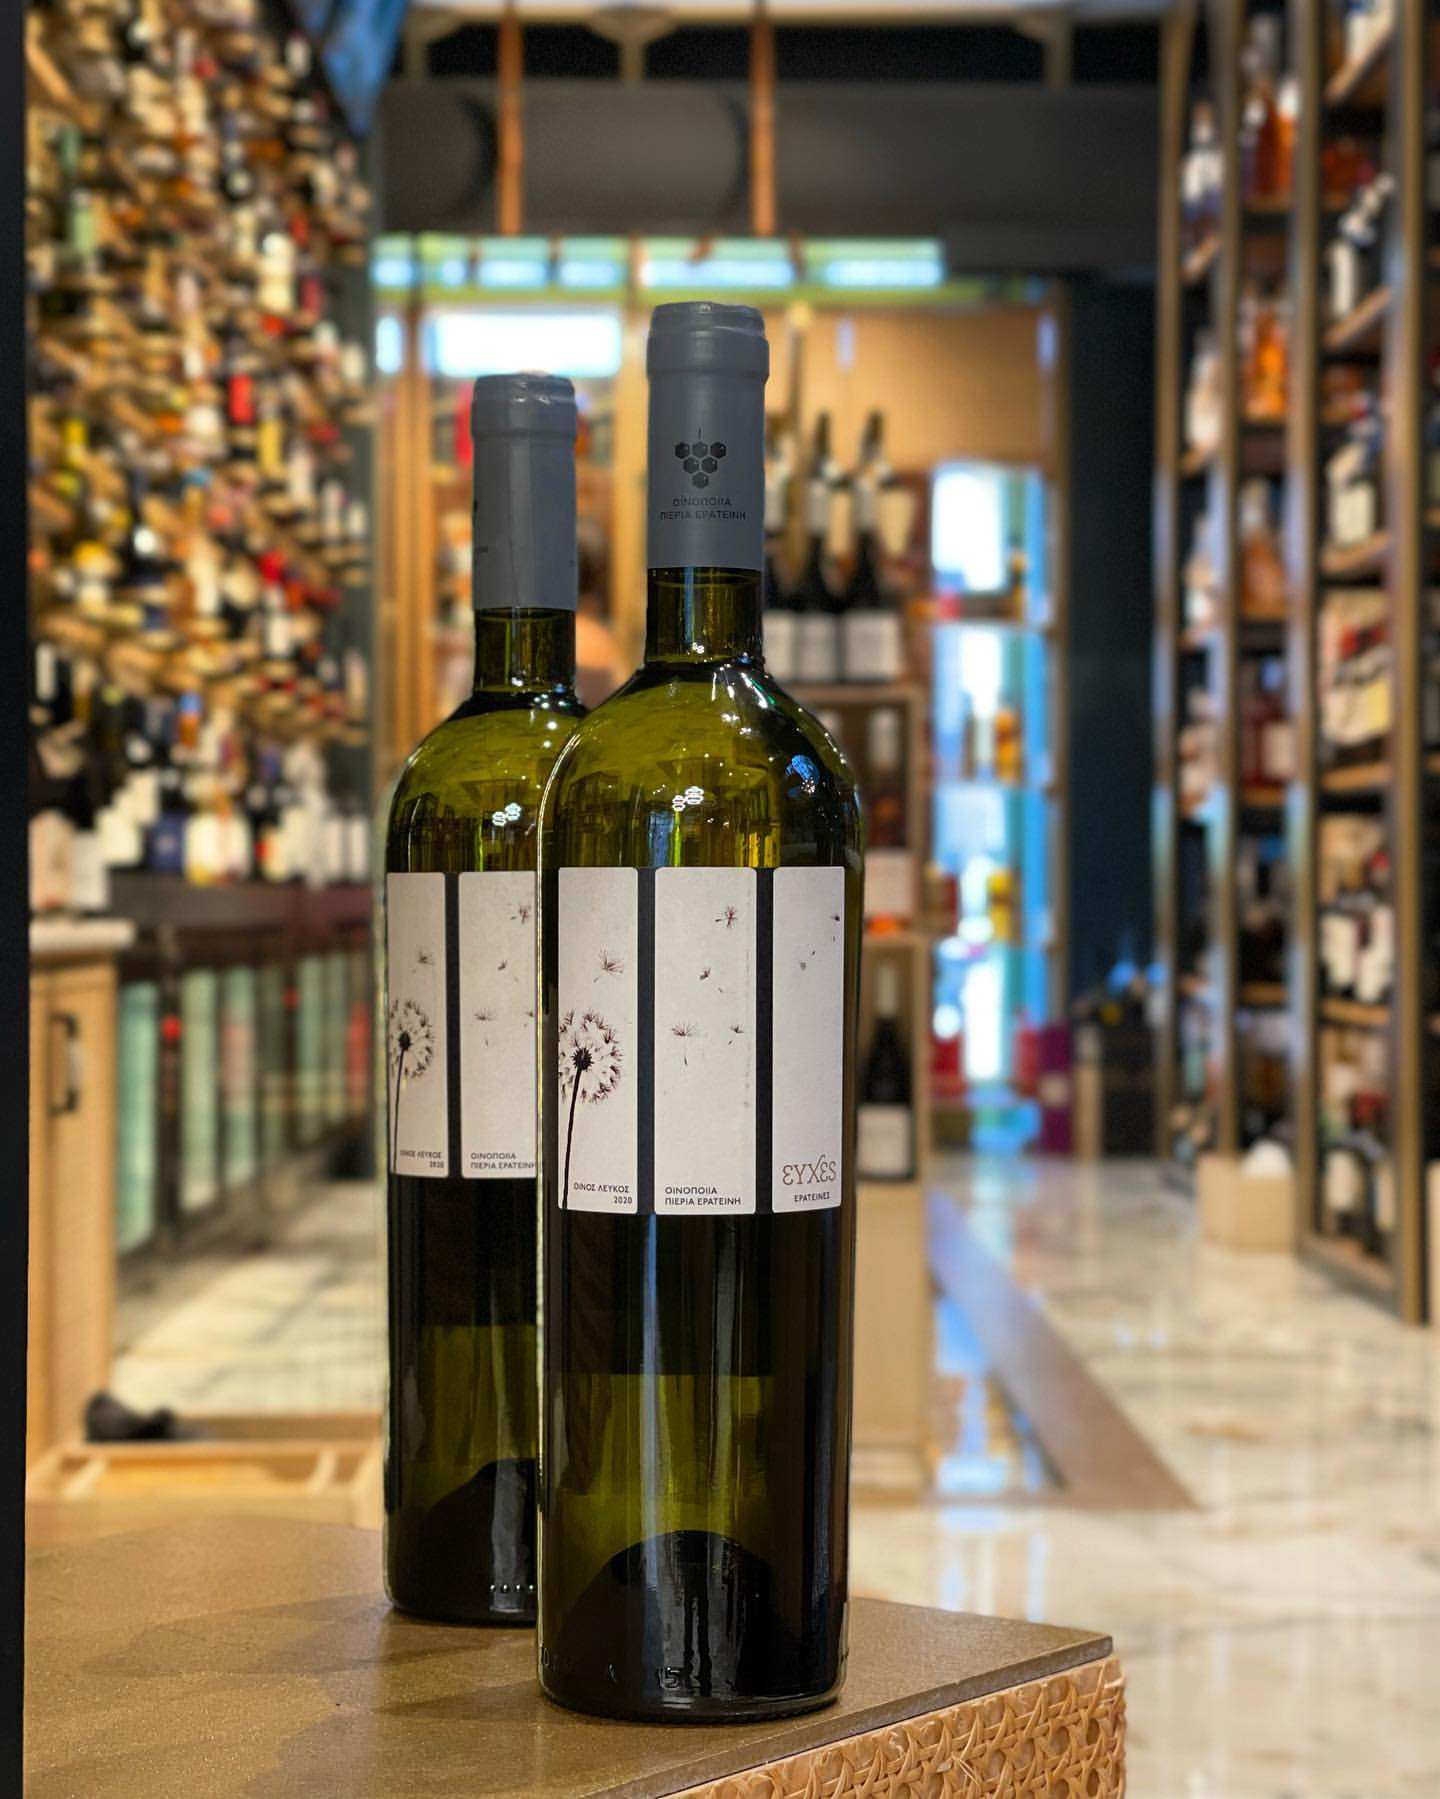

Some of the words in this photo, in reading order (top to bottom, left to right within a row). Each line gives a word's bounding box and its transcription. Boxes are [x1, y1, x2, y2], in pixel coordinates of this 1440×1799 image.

[597, 1184, 630, 1194] ΛΕΥΚΟΣ
[613, 1196, 633, 1205] 2020
[664, 1197, 695, 1206] ΠΙΕΡΙΑ
[697, 1197, 742, 1206] ΕΡΑΤΕΙΝΗ
